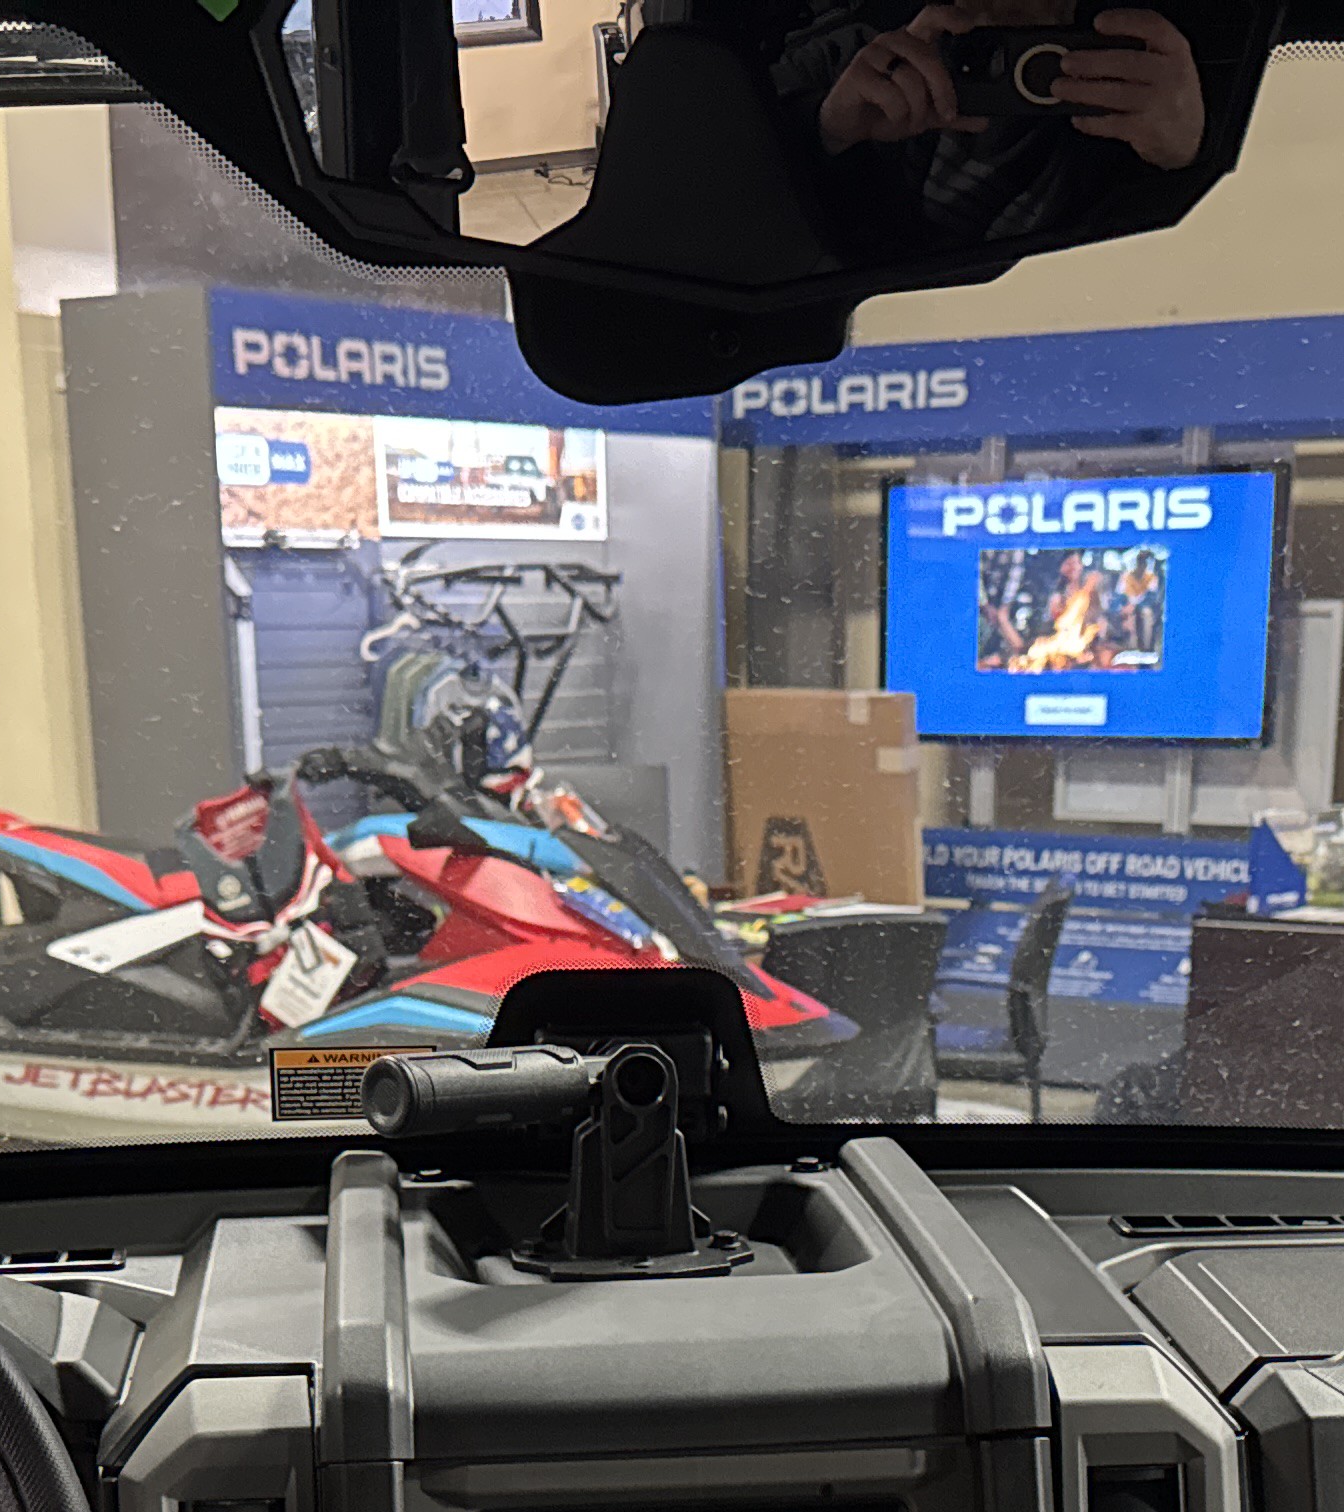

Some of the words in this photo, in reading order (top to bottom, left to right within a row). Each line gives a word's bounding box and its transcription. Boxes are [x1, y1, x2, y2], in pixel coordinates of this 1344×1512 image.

[232, 327, 450, 391] POLARIS
[732, 367, 969, 419] POLARIS
[942, 486, 1213, 537] POLARIS
[952, 844, 1001, 868] YOUR
[1002, 845, 1083, 874] POLARIS
[1085, 851, 1124, 875] OFF
[1124, 853, 1181, 879] ROAD
[1183, 856, 1251, 883] VEHICL
[323, 1053, 389, 1064] WARNI
[2, 1061, 271, 1113] JETBLASTER
